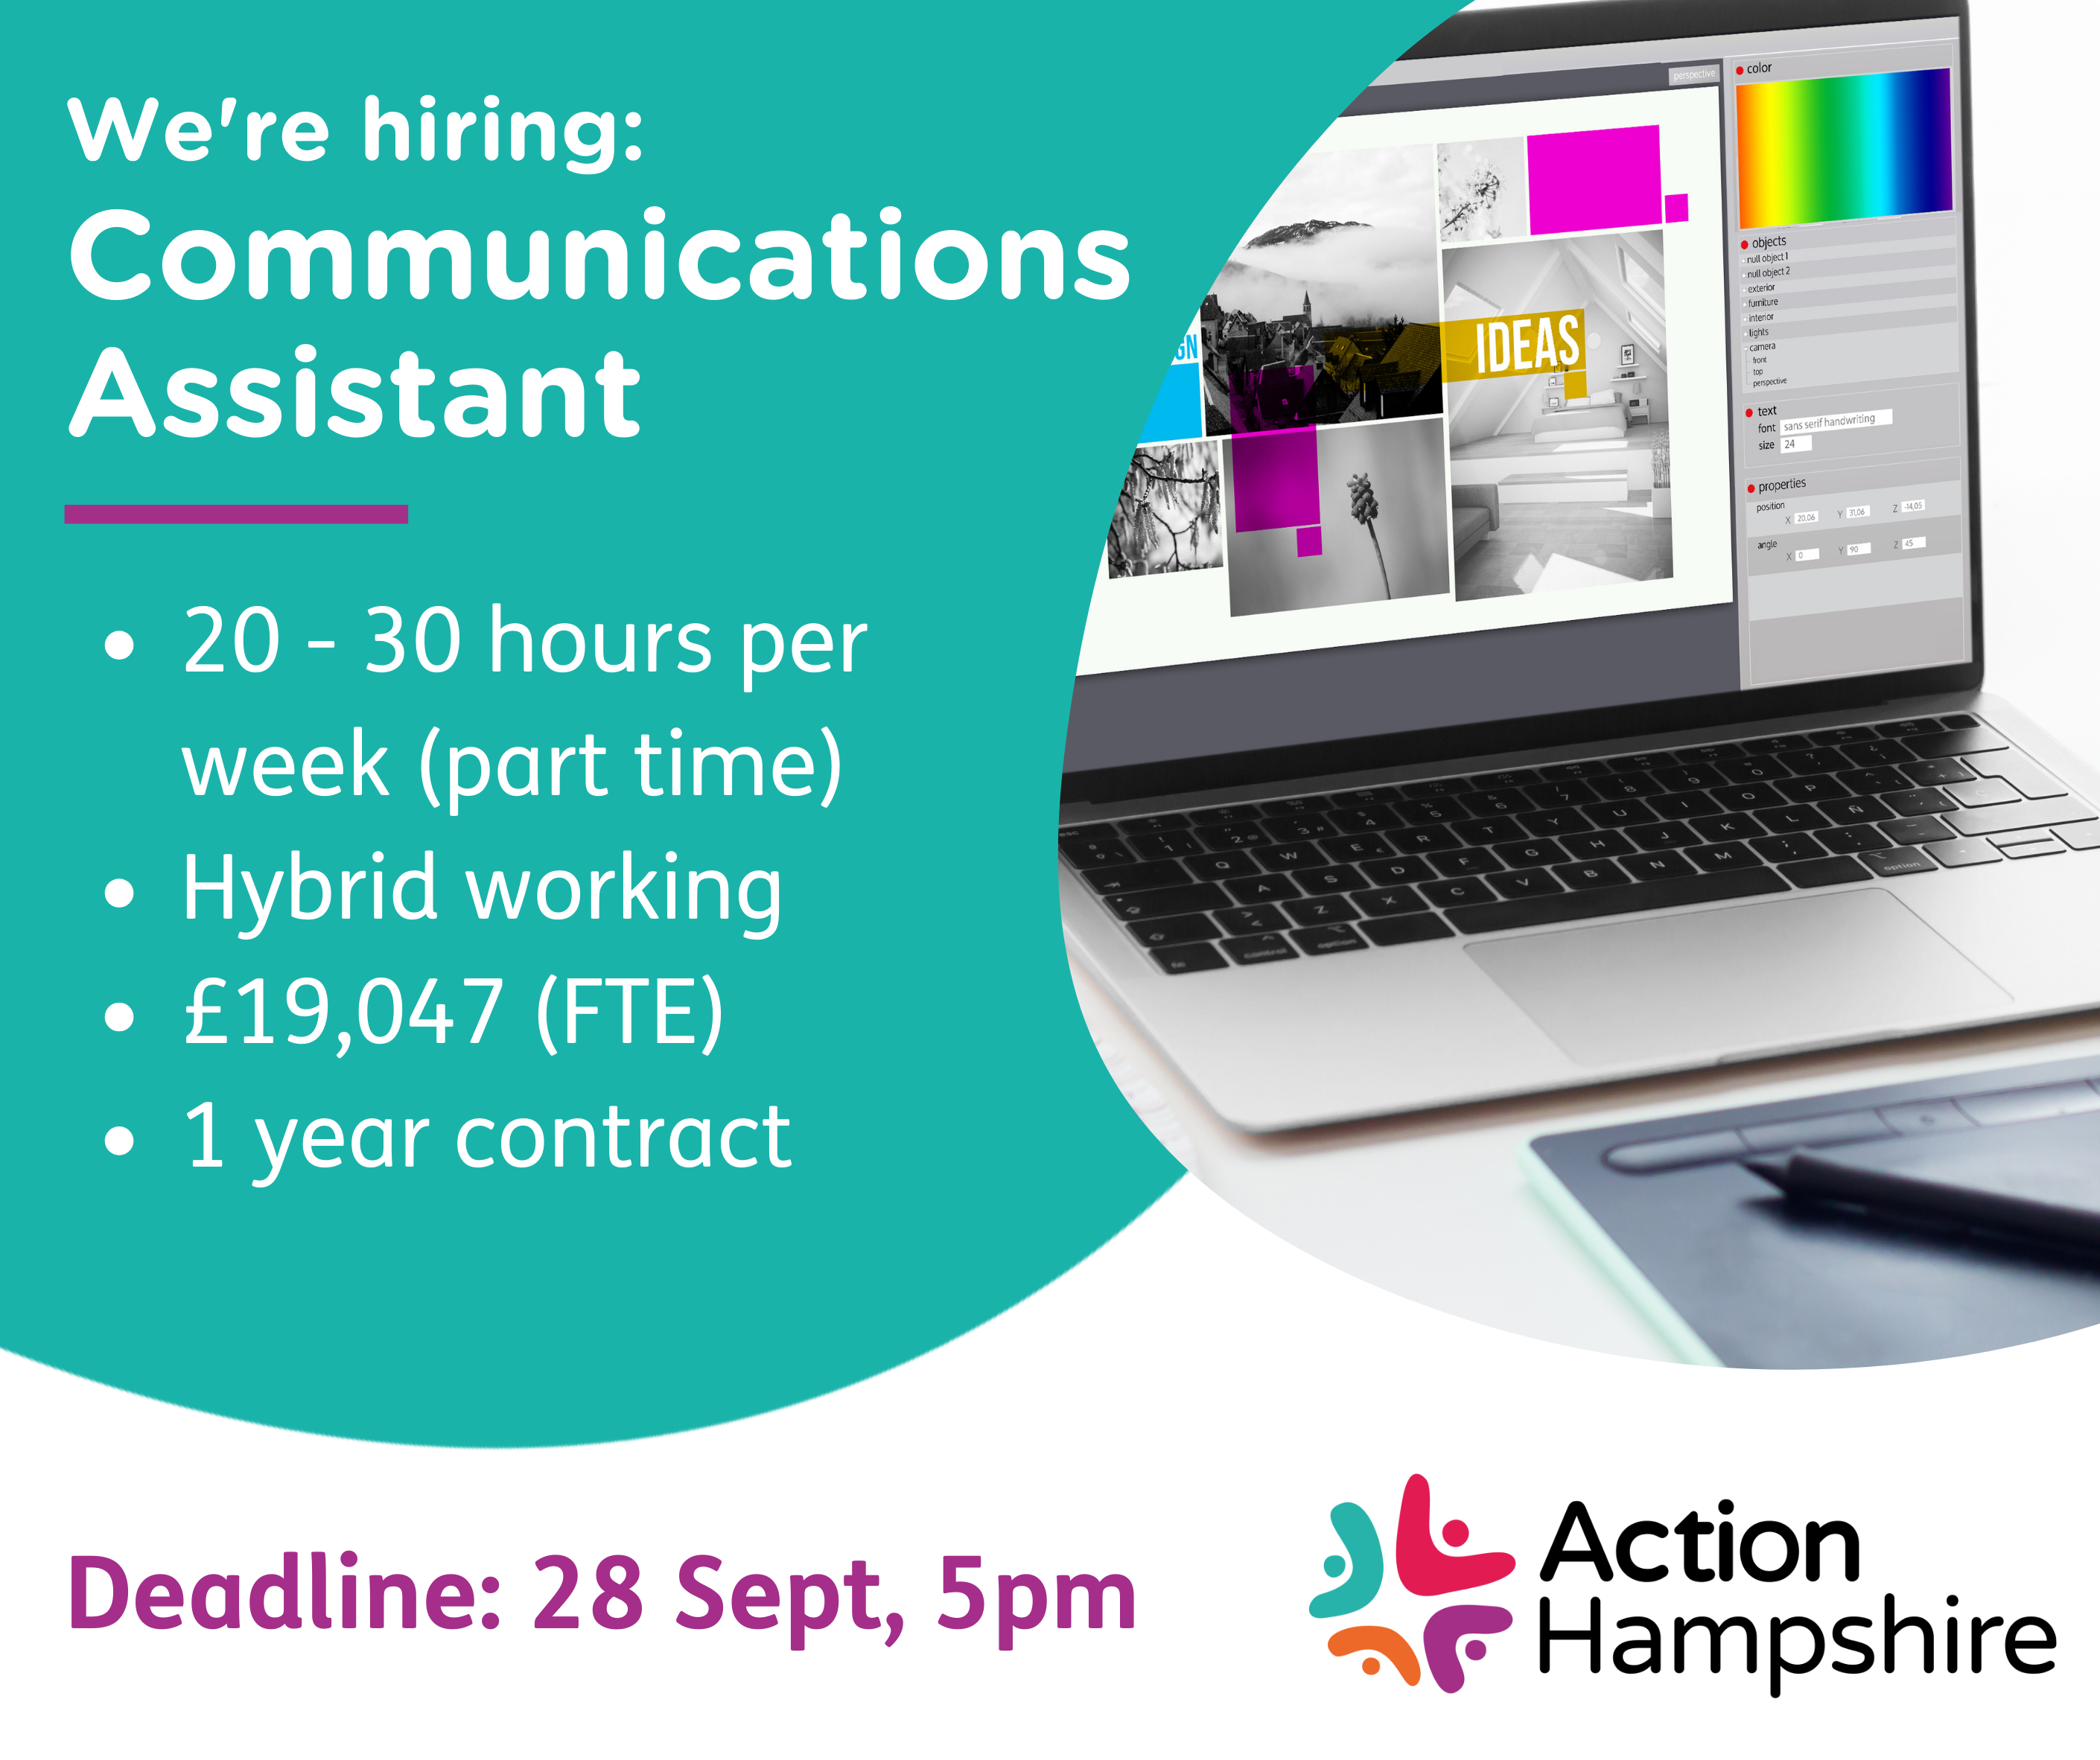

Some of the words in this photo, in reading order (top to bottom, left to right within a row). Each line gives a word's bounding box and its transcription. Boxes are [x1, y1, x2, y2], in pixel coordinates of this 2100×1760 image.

[1747, 62, 1772, 74] color
[1673, 68, 1716, 83] perspective
[1752, 235, 1786, 251] objects
[1747, 254, 1761, 264] null
[1763, 252, 1784, 264] object
[1785, 252, 1788, 261] 1
[1747, 269, 1761, 278] null
[1763, 267, 1785, 279] object
[1786, 266, 1790, 275] 2
[1748, 283, 1775, 293] exterior
[1749, 298, 1778, 307] furniture
[1749, 313, 1774, 322] interior
[1749, 328, 1769, 339] lights
[1477, 314, 1579, 373] IDEAS
[1749, 342, 1776, 352] camera
[1753, 369, 1763, 377] top
[1753, 378, 1787, 389] perspective
[1757, 406, 1778, 417] text
[1757, 423, 1776, 433] font
[1784, 421, 1803, 431] sans
[1804, 416, 1823, 429] serif
[1824, 413, 1875, 427] handwriting
[1759, 440, 1775, 450] size
[1784, 439, 1795, 449] 24
[1759, 477, 1807, 495] properties
[1757, 501, 1785, 514] position
[1785, 515, 1791, 525] X
[1837, 510, 1843, 519] Y
[1892, 504, 1898, 513] Z
[1757, 540, 1778, 551] angle
[1786, 552, 1792, 561] X
[1838, 546, 1844, 555] Y
[1893, 541, 1899, 549] Z
[1848, 805, 1864, 814] Ñ
[1720, 823, 1735, 831] K
[1590, 840, 1606, 848] H
[1279, 852, 1297, 860] W
[1714, 852, 1732, 860] M
[1458, 858, 1469, 866] F
[1649, 861, 1666, 869] N
[1883, 861, 1921, 871] option
[1390, 867, 1405, 875] D
[1583, 870, 1598, 878] B
[1324, 875, 1338, 883] S
[1515, 878, 1529, 886] V
[1451, 887, 1465, 896] C
[1382, 896, 1396, 905] X
[1314, 905, 1329, 914] Z
